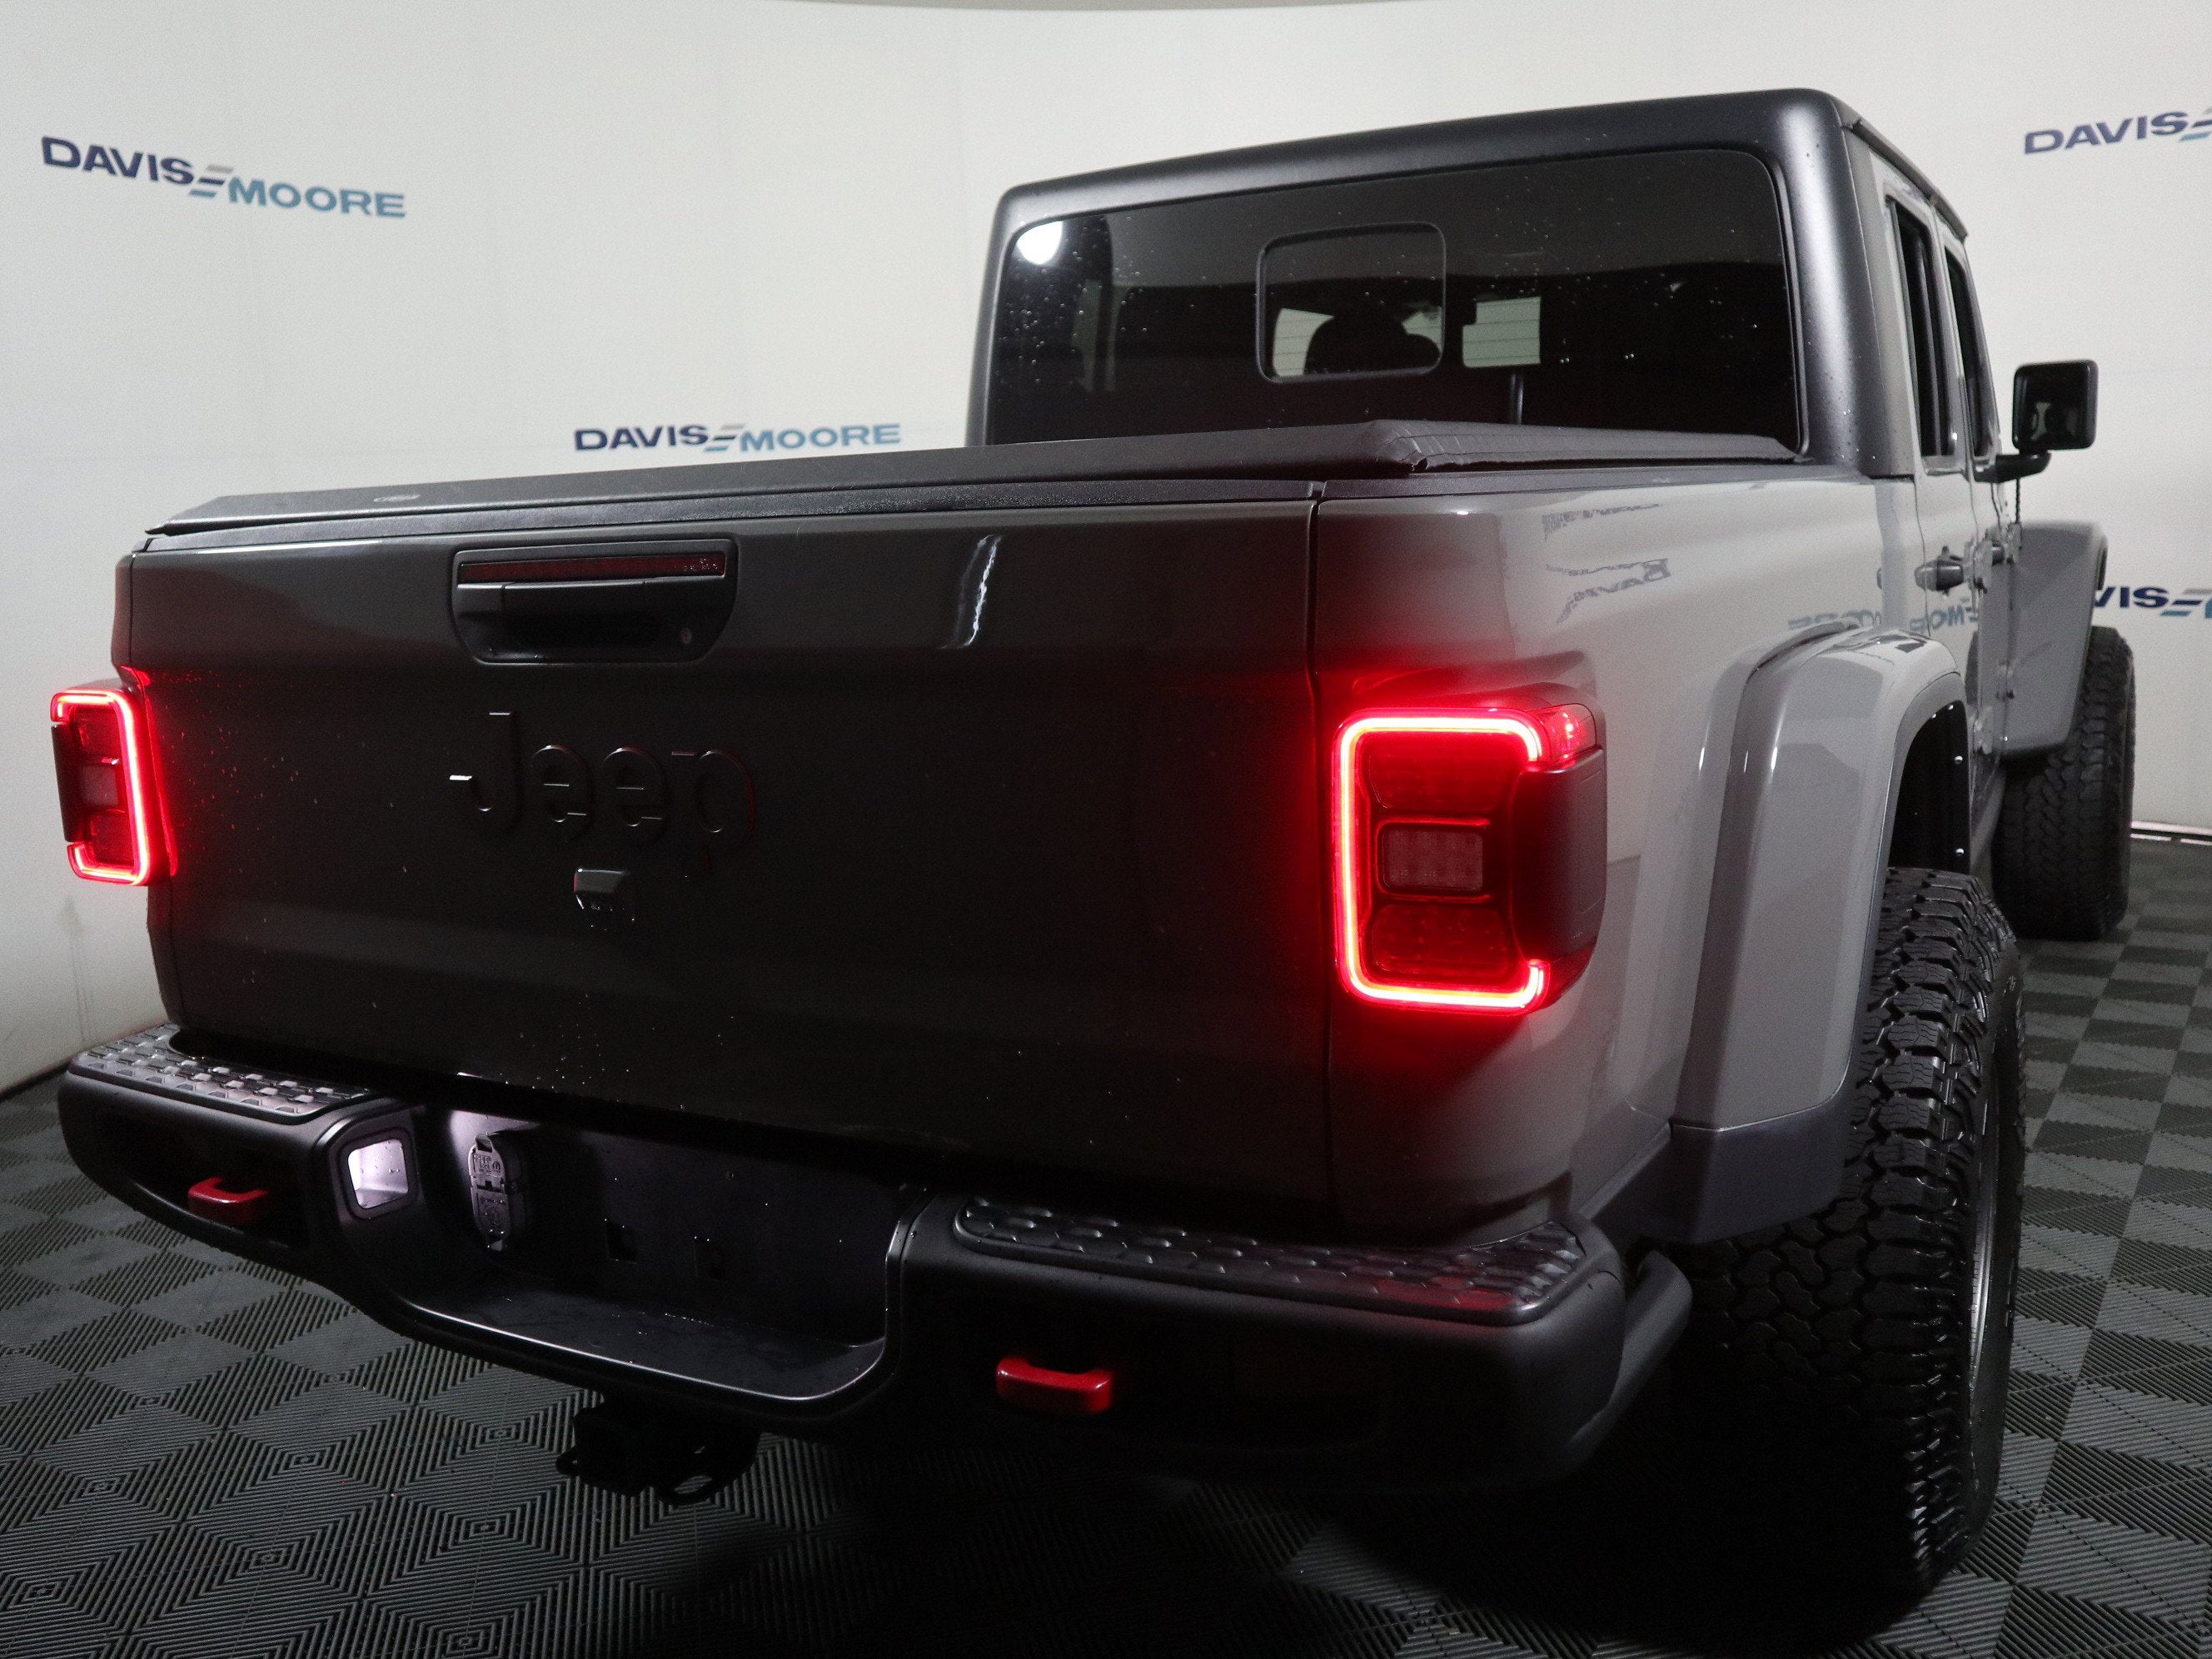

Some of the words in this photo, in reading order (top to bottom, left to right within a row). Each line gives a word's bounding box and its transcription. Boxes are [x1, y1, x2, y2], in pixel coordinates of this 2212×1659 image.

[2024, 111, 2189, 155] DAVIS
[41, 136, 195, 185] DAVIS
[227, 176, 407, 218] MOORE
[574, 424, 709, 451] DAVIS
[739, 423, 901, 452] MOORE
[448, 710, 756, 881] Jeep
